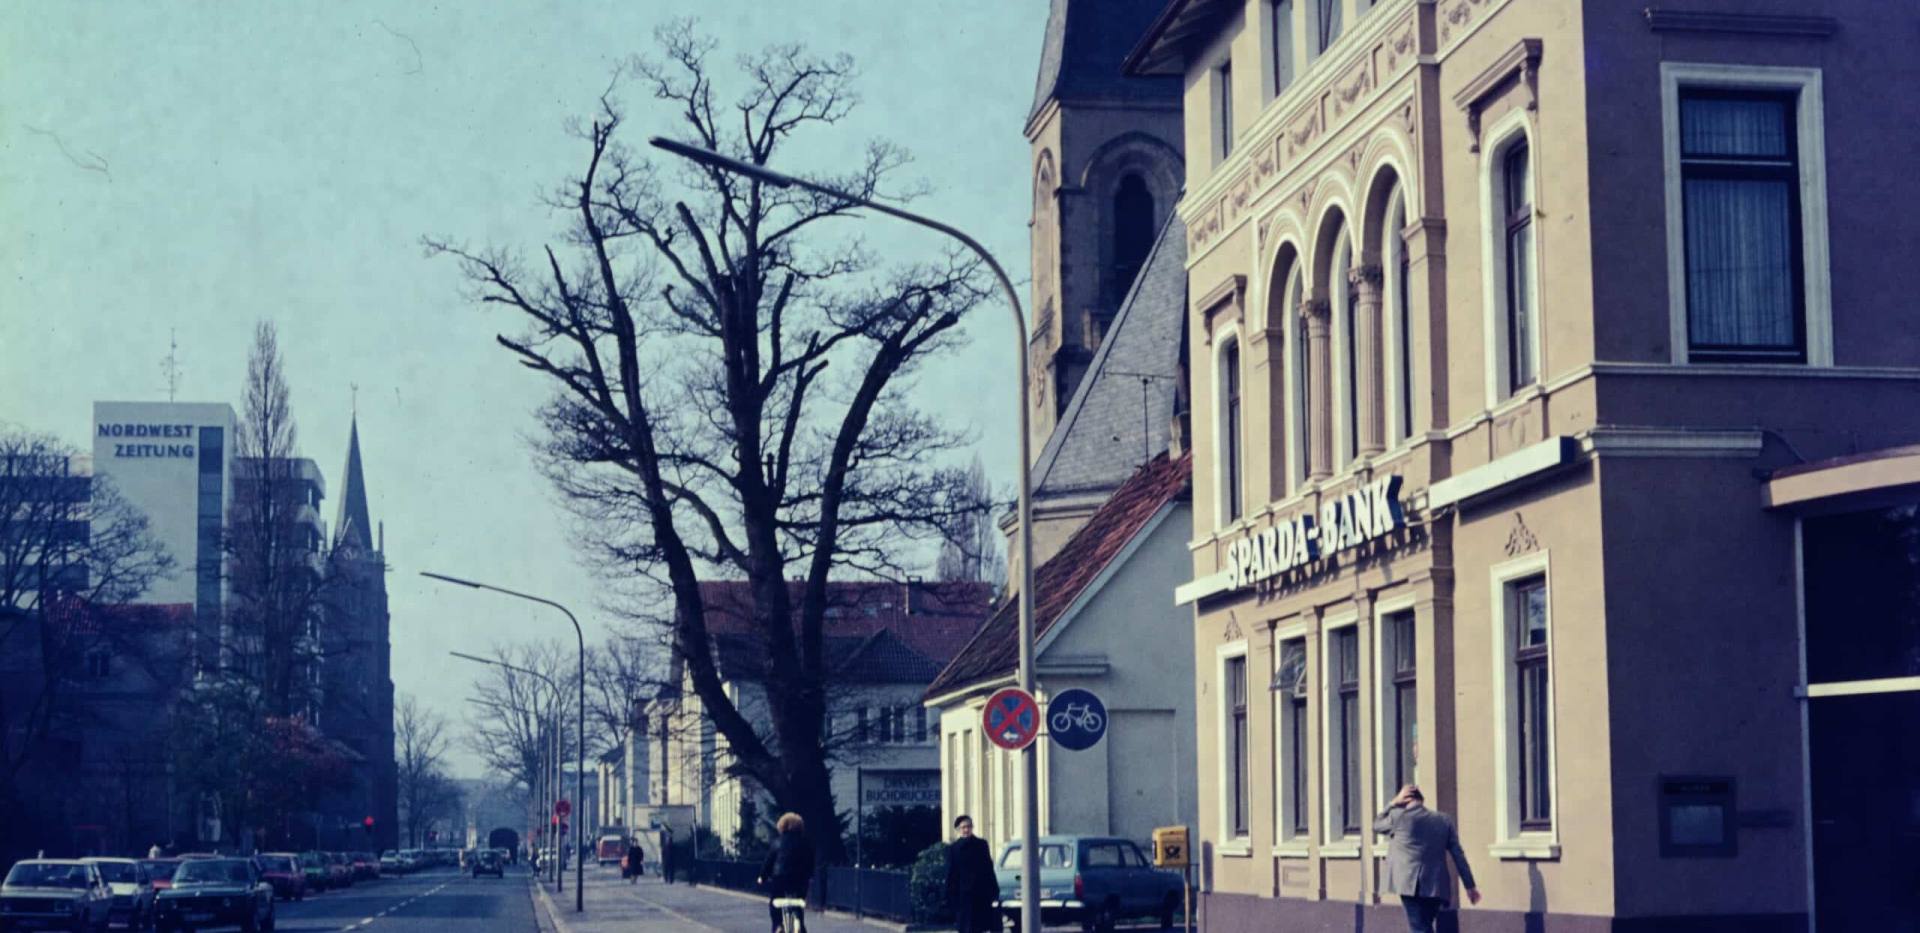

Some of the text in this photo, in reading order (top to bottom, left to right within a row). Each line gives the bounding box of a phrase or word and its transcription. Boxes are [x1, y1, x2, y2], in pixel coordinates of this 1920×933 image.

[98, 424, 194, 438] NORDWEST
[114, 444, 195, 458] ZEITUNG
[1227, 474, 1397, 591] SPARDA-BANK
